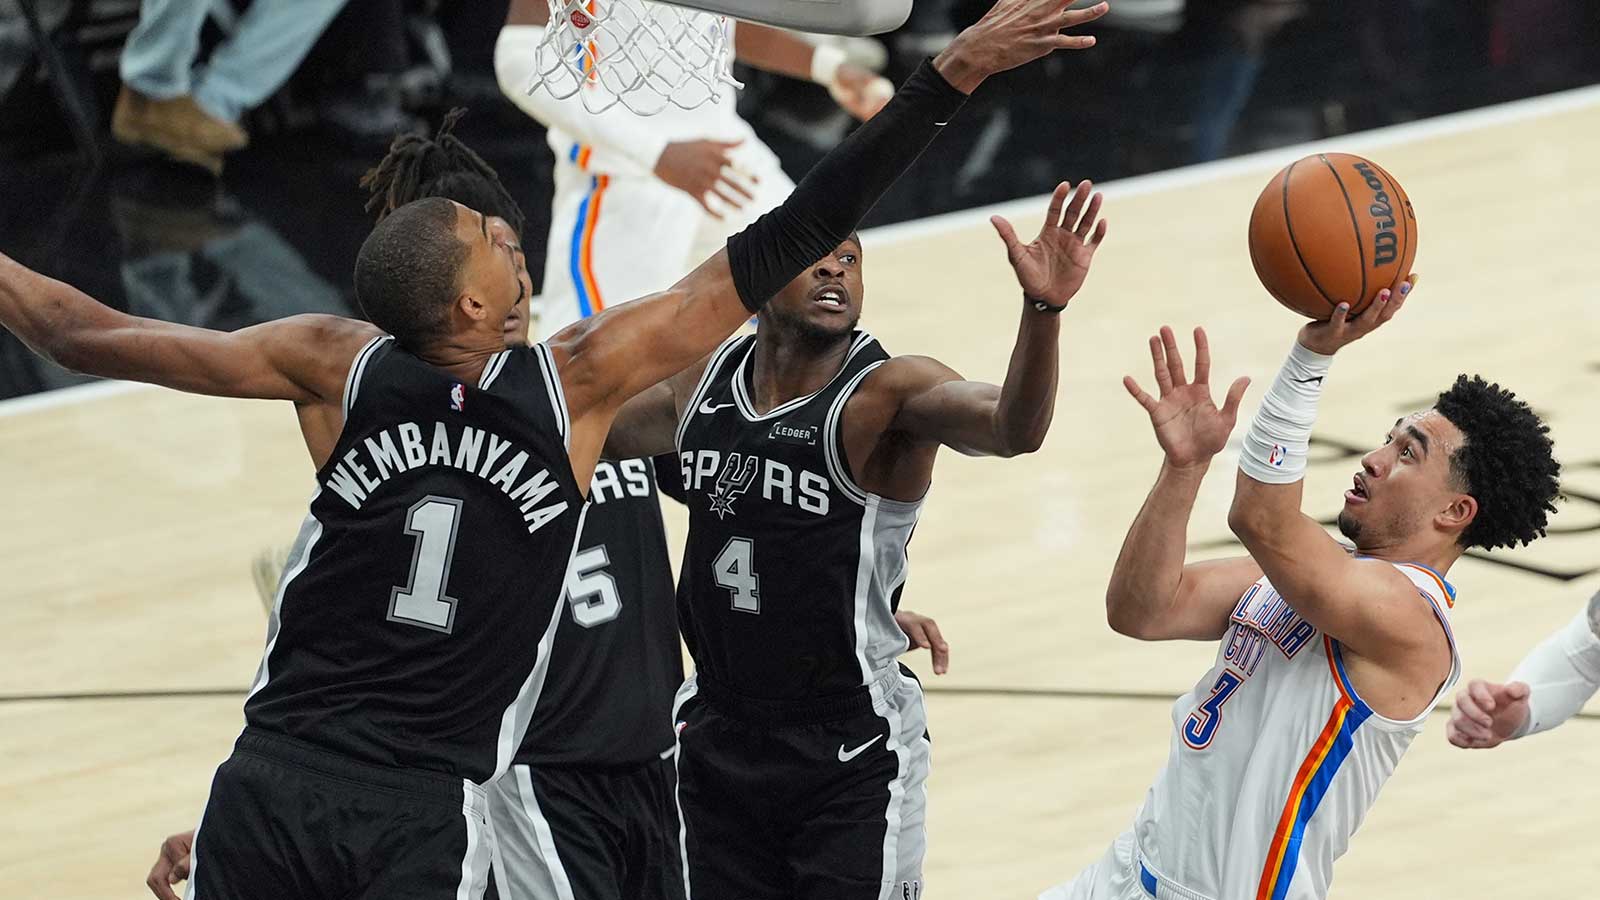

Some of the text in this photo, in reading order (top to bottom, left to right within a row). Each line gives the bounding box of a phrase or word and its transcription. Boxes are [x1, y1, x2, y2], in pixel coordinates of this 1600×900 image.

[1352, 162, 1399, 268] Wilson
[775, 426, 811, 440] LEDGER
[326, 421, 569, 534] WEMBANYAMA
[681, 450, 830, 520] SPURS
[385, 494, 464, 635] 1
[568, 543, 623, 629] 5
[711, 536, 760, 615] 4
[1223, 624, 1269, 677] CITY
[1181, 668, 1245, 750] 3
